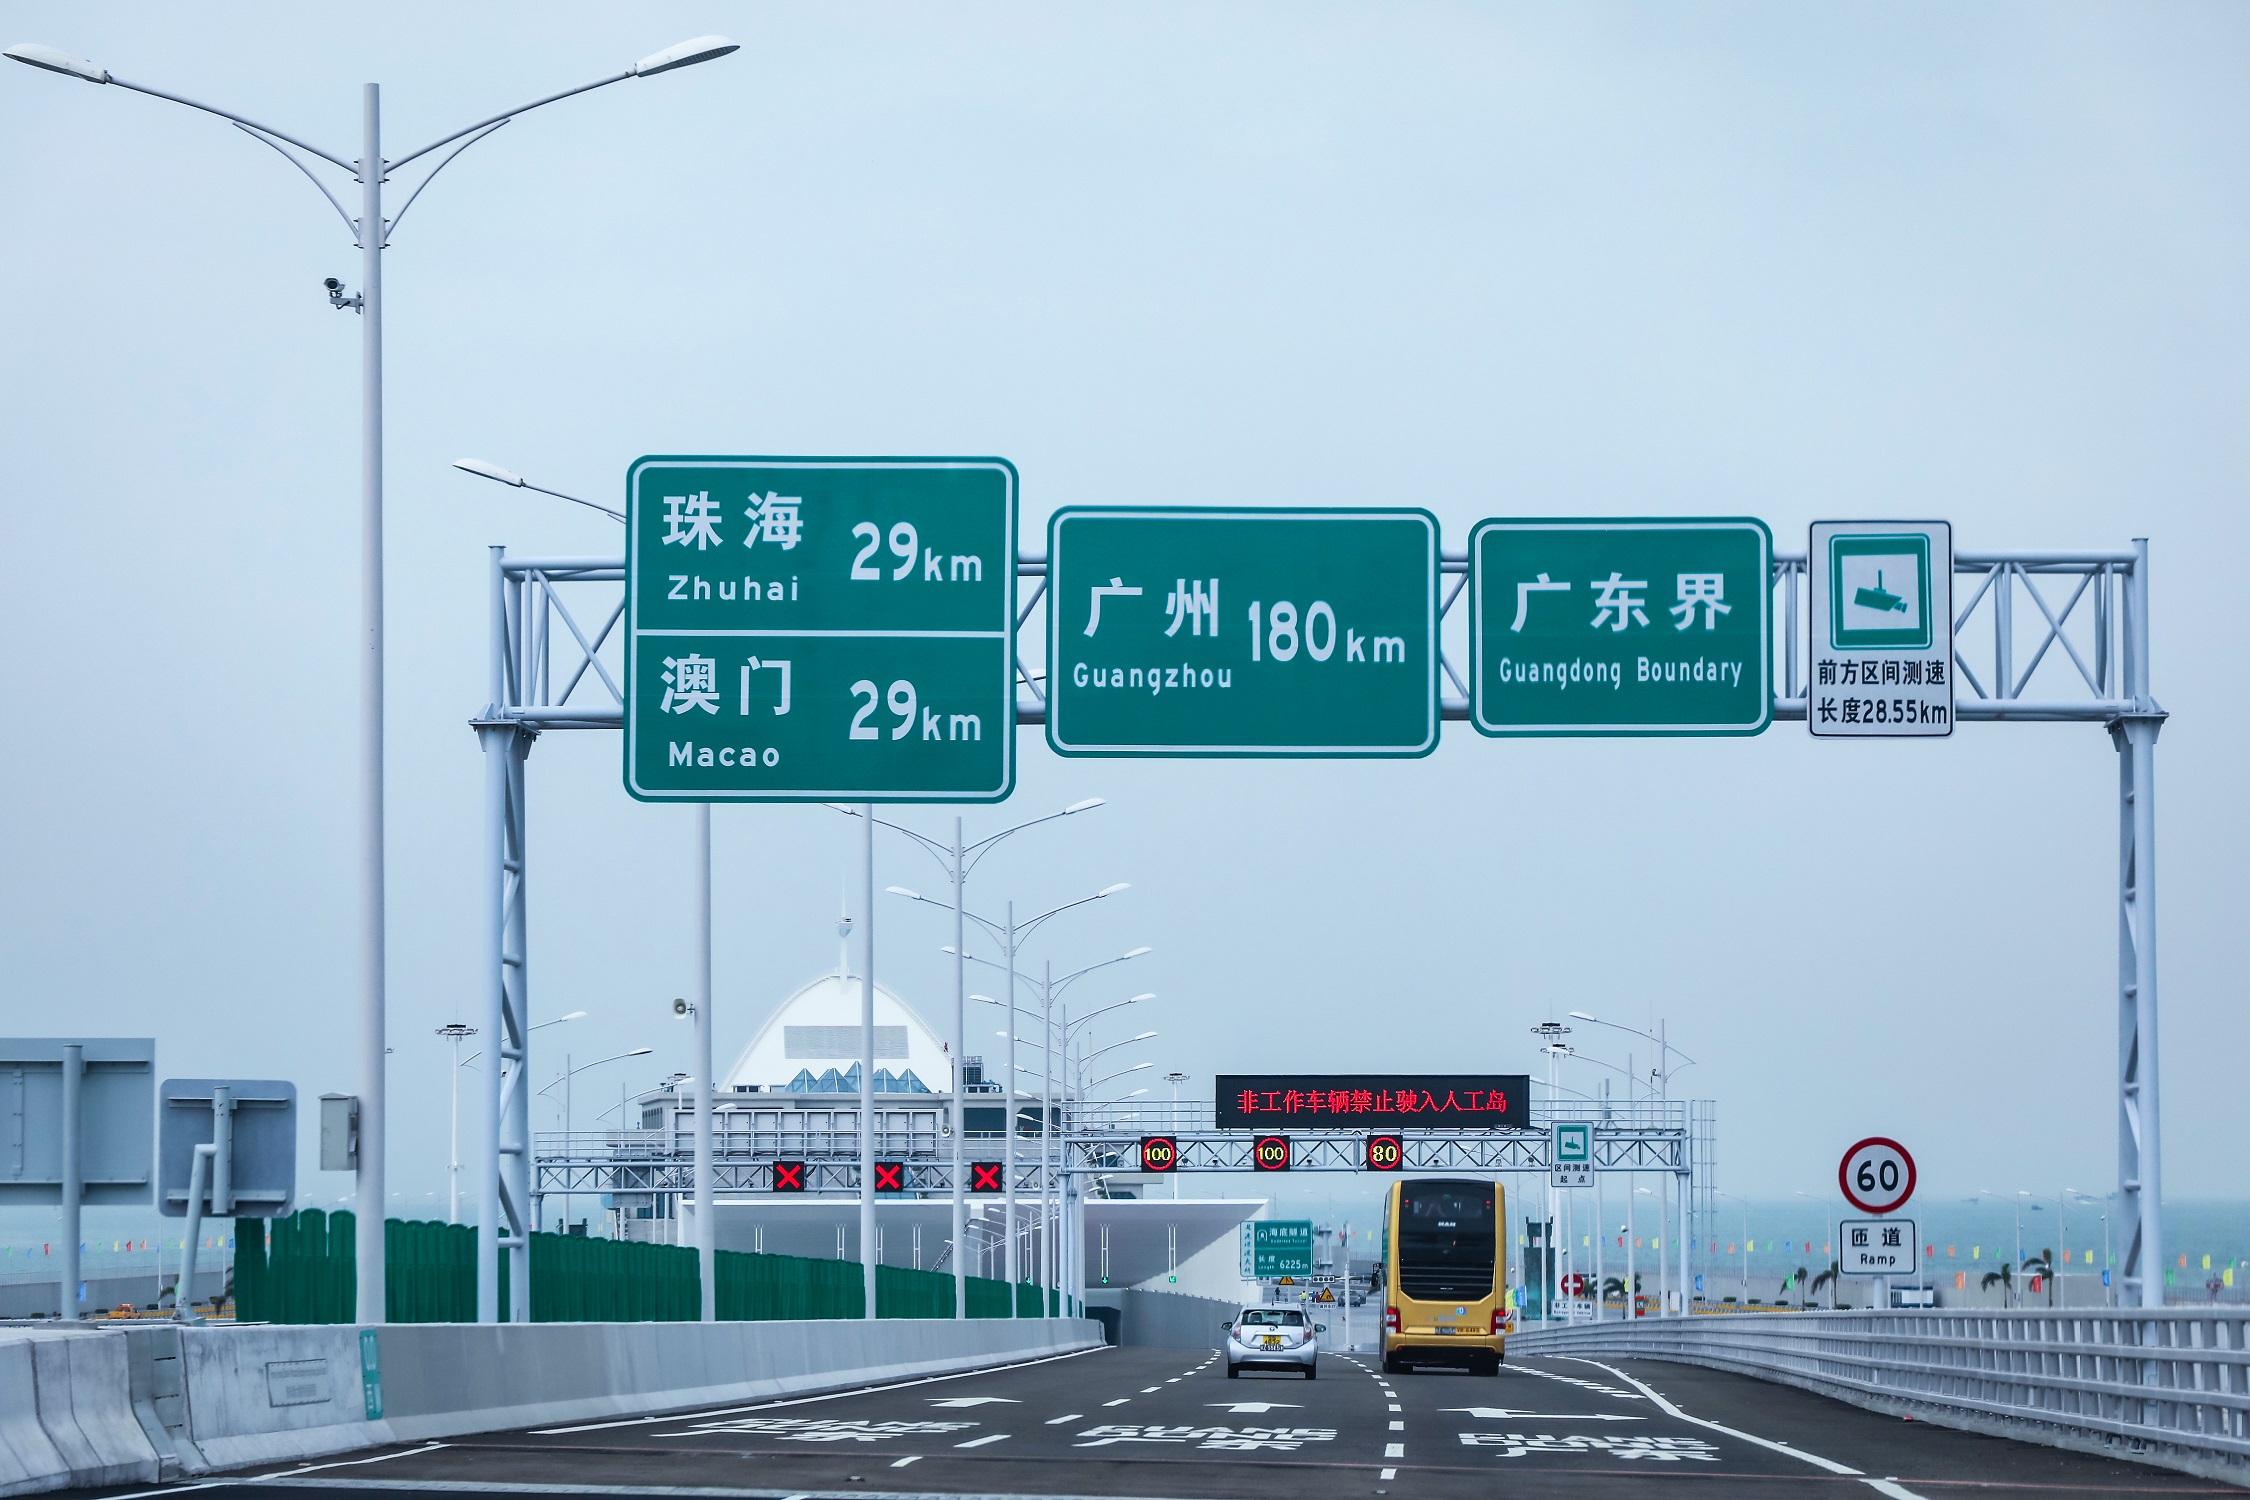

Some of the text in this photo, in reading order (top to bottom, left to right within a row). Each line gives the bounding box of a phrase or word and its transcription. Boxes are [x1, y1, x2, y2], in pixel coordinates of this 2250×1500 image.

[662, 491, 804, 550] 珠海
[668, 575, 798, 601] Zhuhai
[1083, 576, 1219, 637] 广州
[1509, 572, 1732, 633] 广东界
[660, 653, 791, 716] 澳门
[1073, 662, 1231, 696] Guangzhou
[1500, 656, 1743, 690] Guangdong Boundary
[1817, 659, 1946, 686] 前方区间测速
[1817, 696, 1947, 725] 长度28.55km
[669, 741, 780, 767] Macao
[1237, 1089, 1508, 1114] 非工作车辆禁止驶入人工岛
[1144, 1147, 1171, 1161] 100
[1258, 1147, 1284, 1161] 100
[1372, 1145, 1397, 1162] 80
[1554, 1163, 1590, 1172] 区间测速
[1560, 1175, 1586, 1184] 起点
[1857, 1159, 1899, 1192] 60
[1851, 1227, 1901, 1248] 匝道
[1860, 1253, 1896, 1269] Ramp
